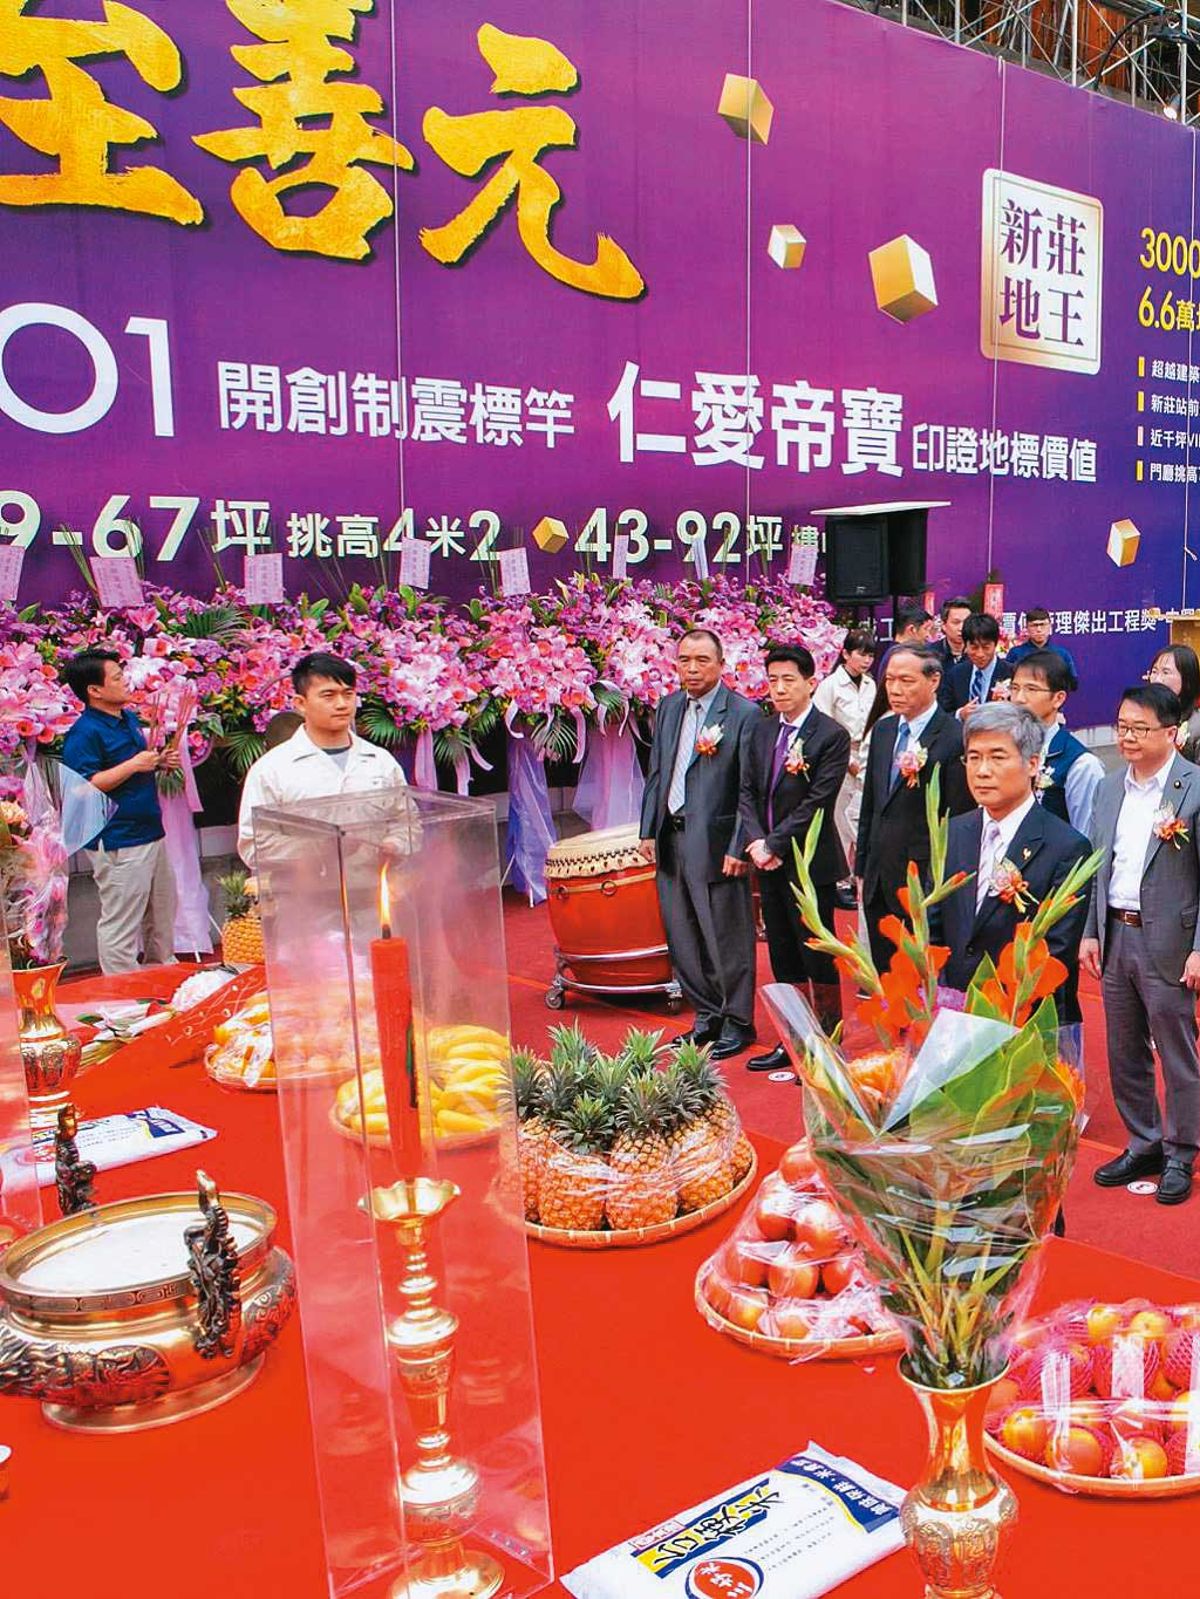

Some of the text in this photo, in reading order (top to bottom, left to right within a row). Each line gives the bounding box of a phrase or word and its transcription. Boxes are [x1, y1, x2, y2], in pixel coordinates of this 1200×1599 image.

[1000, 198, 1088, 278] 新莊
[999, 278, 1085, 347] 地王
[217, 360, 575, 449] 開創制震標竿
[607, 360, 904, 478] 仁愛帝寶
[912, 422, 1098, 484] 印證地標價值
